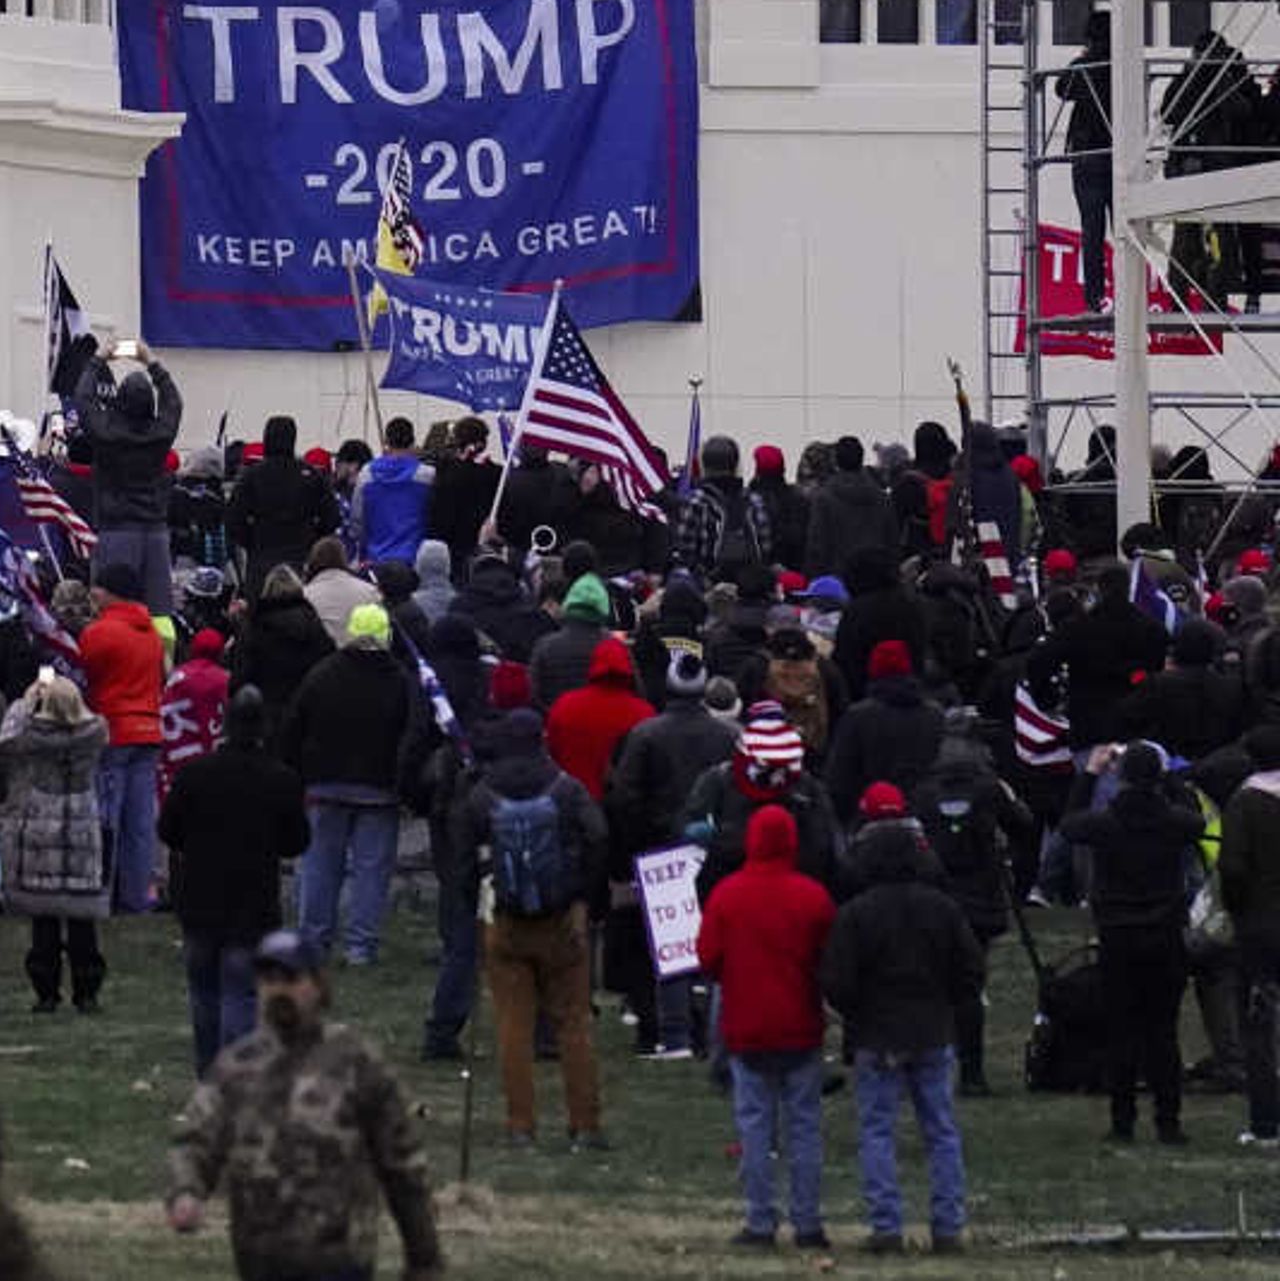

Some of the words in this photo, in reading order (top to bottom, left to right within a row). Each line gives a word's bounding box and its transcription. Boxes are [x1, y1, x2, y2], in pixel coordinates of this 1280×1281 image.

[197, 233, 296, 268] KEEP
[312, 229, 501, 268] AMICA
[517, 204, 657, 256] GREAT!
[390, 296, 543, 363] TRUM
